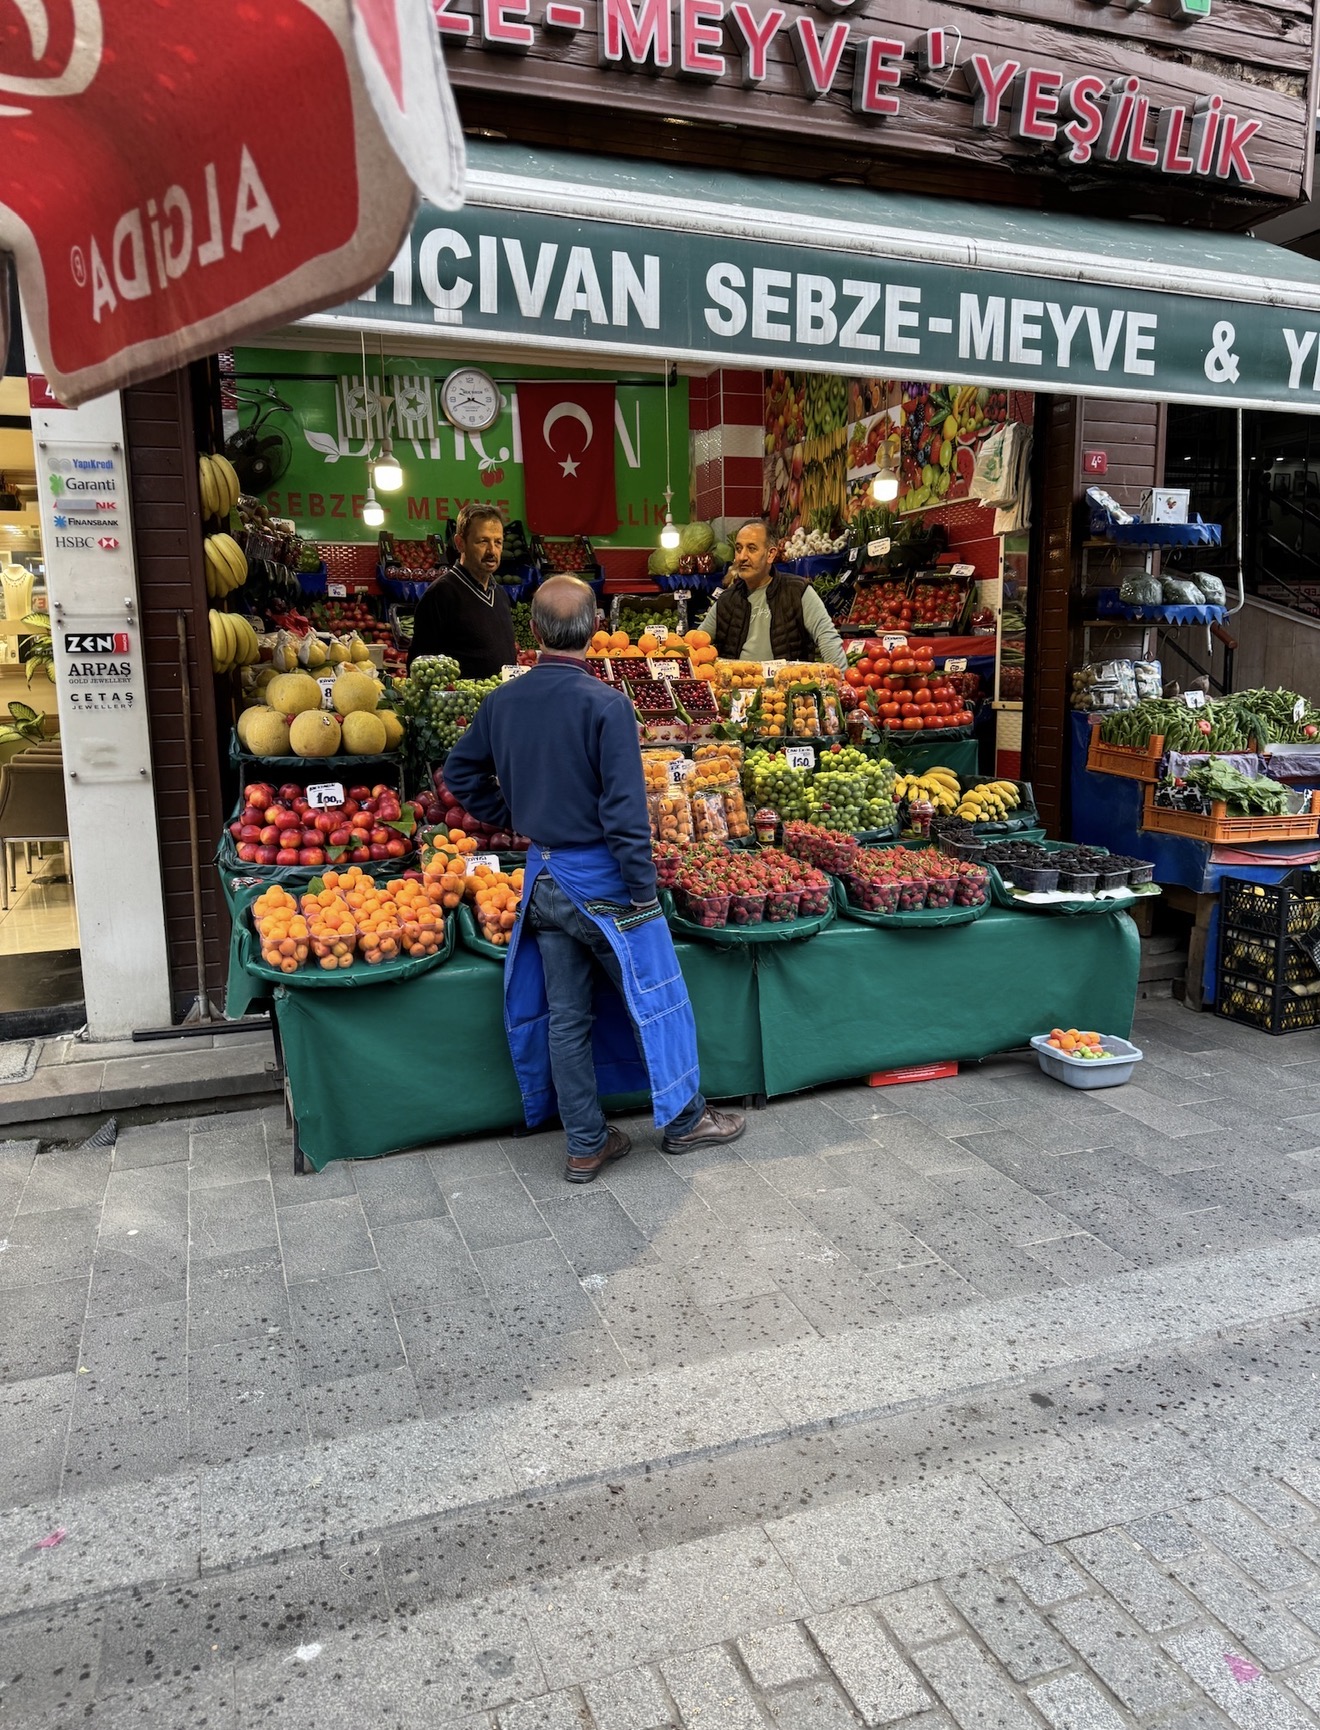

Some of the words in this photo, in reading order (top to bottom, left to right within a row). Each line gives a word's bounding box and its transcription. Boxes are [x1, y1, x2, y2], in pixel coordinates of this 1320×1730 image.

[703, 262, 1158, 376] SEBZE-MEYVE
[1204, 320, 1240, 384] &
[1282, 328, 1320, 390] Y
[66, 477, 116, 491] Garanti
[55, 536, 95, 548] HSBC
[67, 636, 112, 652] ZEN
[67, 662, 132, 677] ARPAŞ
